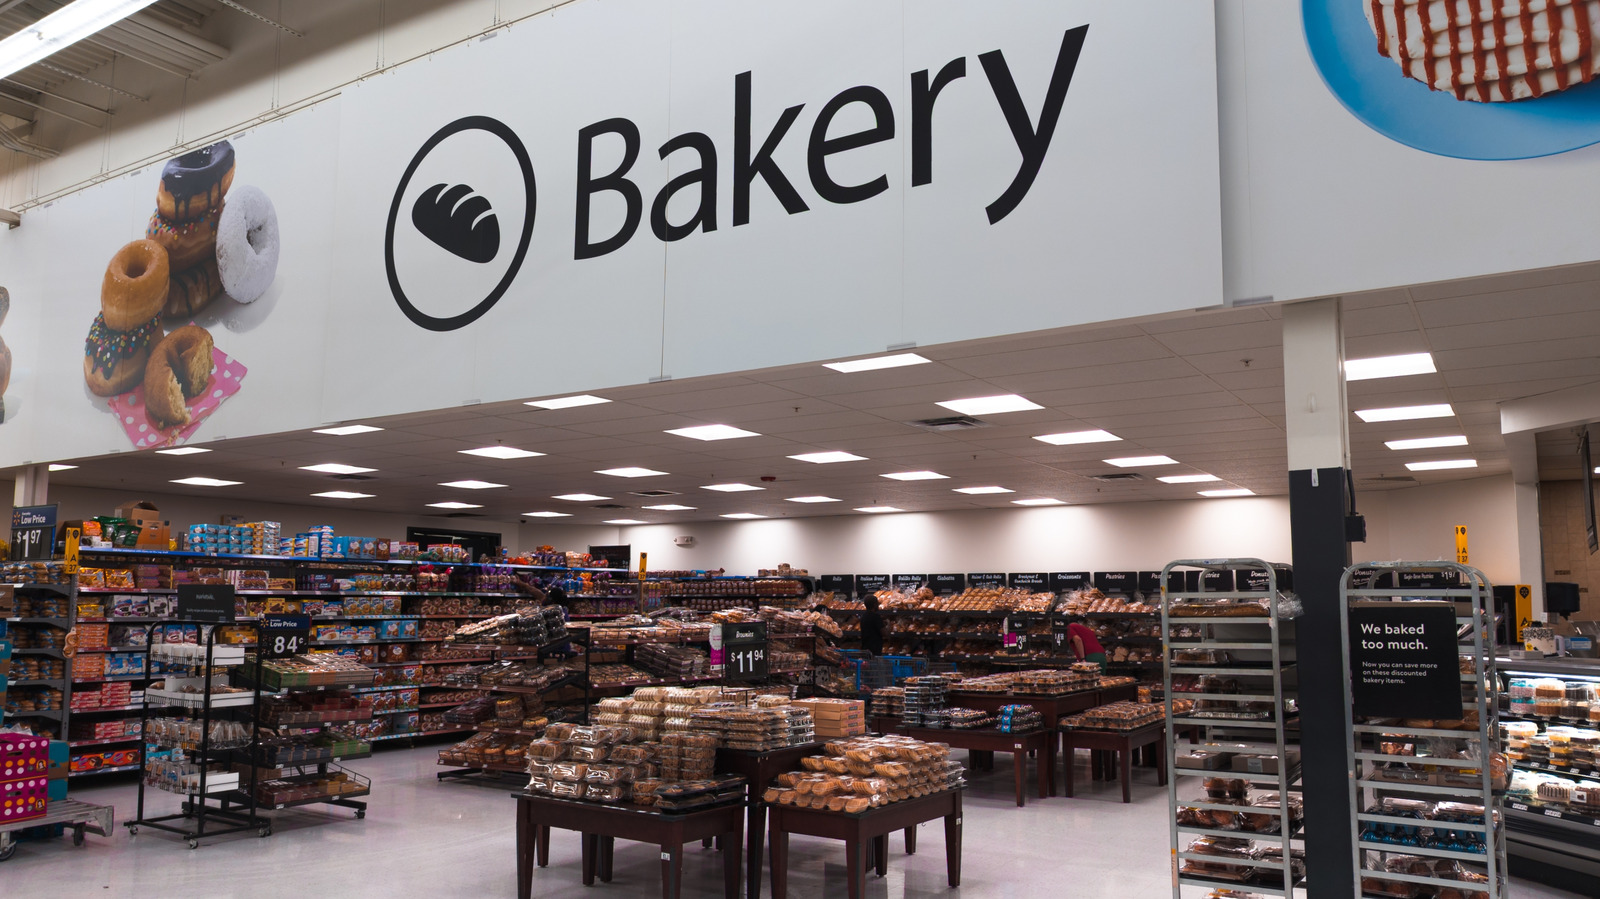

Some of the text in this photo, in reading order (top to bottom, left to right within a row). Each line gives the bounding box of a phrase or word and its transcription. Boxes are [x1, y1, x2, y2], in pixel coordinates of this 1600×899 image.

[574, 23, 1090, 260] Bakery
[21, 514, 46, 525] Low Price
[70, 554, 77, 562] A
[1461, 555, 1468, 563] 37
[68, 564, 77, 572] 37
[1360, 623, 1425, 635] We baked
[736, 630, 754, 638] Brownies
[1361, 639, 1429, 650] too much.
[1390, 669, 1427, 677] discounted
